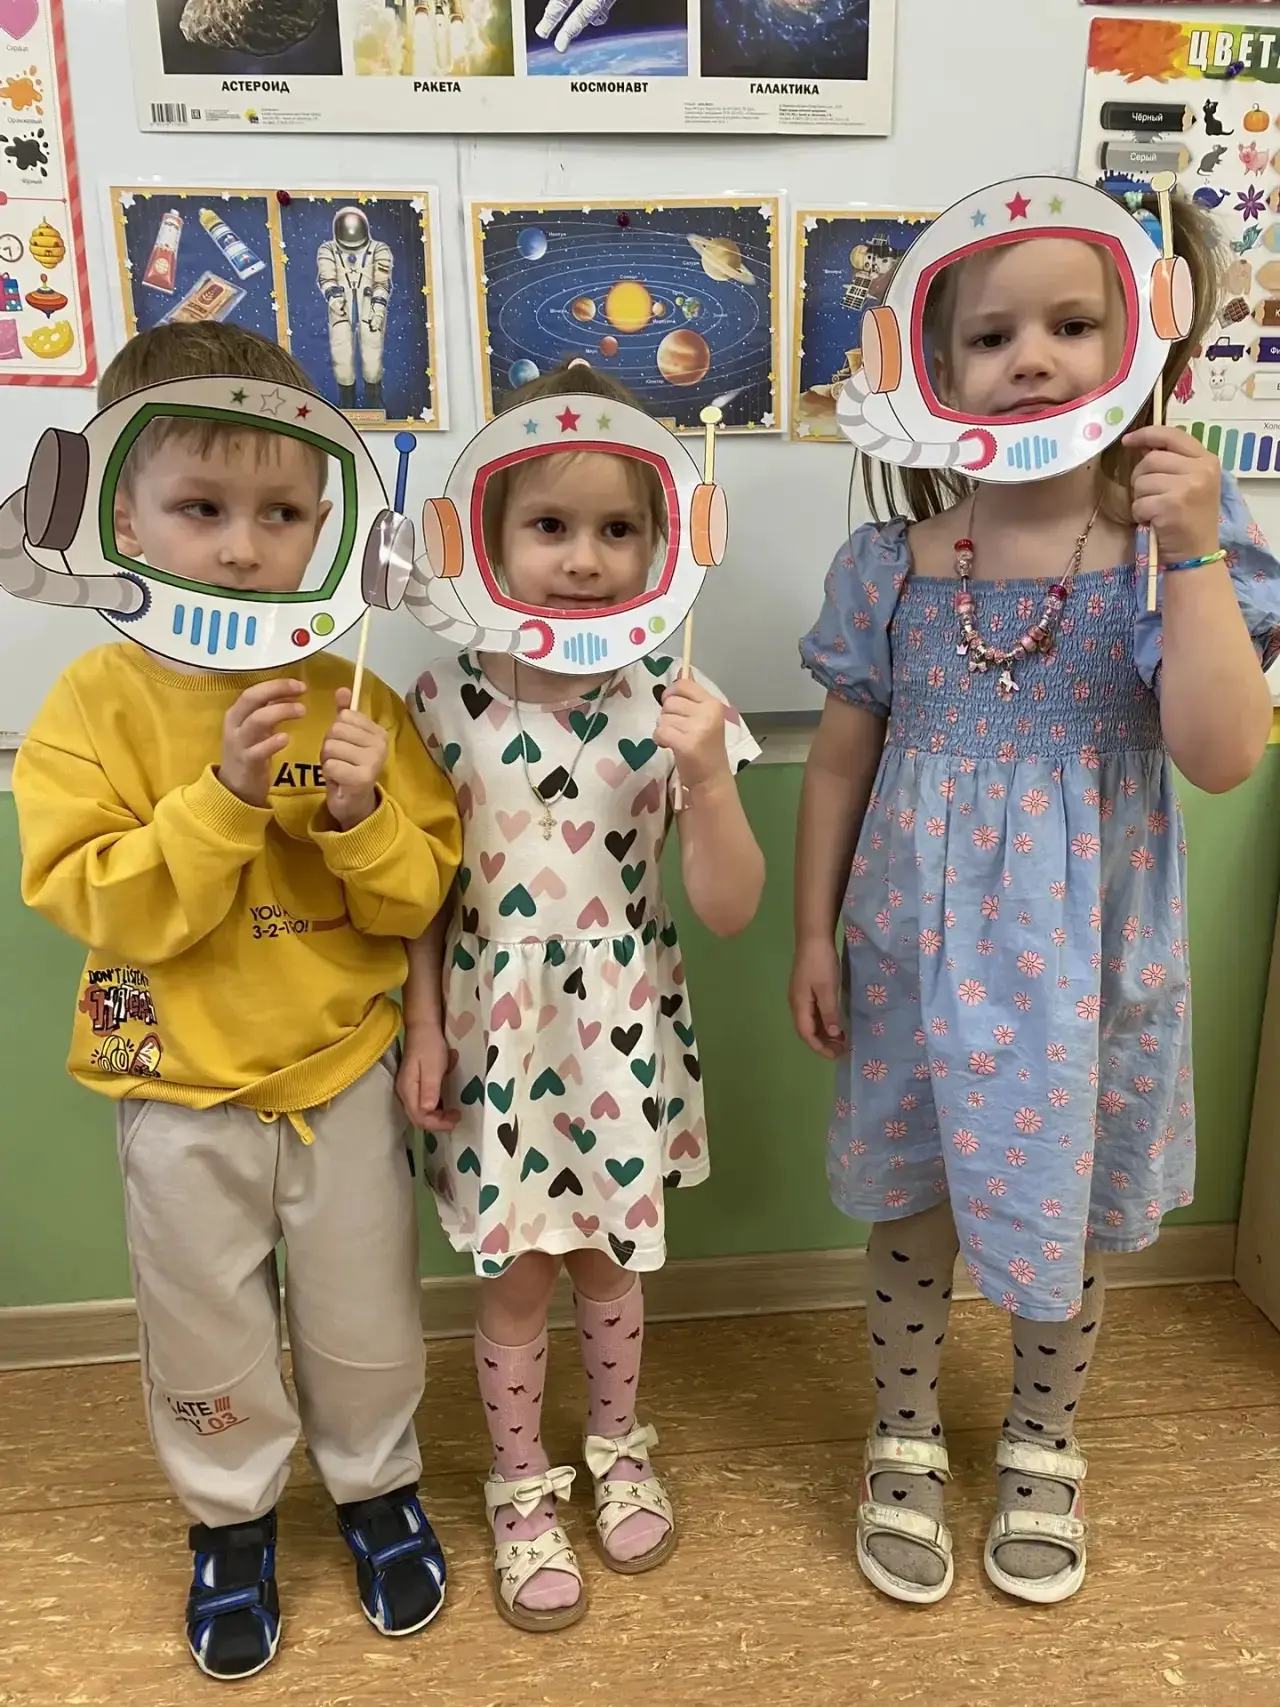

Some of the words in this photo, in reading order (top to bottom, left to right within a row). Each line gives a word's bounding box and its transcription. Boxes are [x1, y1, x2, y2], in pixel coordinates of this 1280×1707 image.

[1188, 30, 1280, 72] ЦВЕТ
[221, 81, 290, 93] АСТЕРОИД
[413, 81, 461, 92] РАКЕТА
[570, 82, 649, 92] КОСМОНАВТ
[750, 83, 820, 95] ГАЛАКТИКА
[1132, 112, 1163, 122] Чёрный
[1130, 153, 1157, 162] Серый
[88, 967, 121, 984] DON'T
